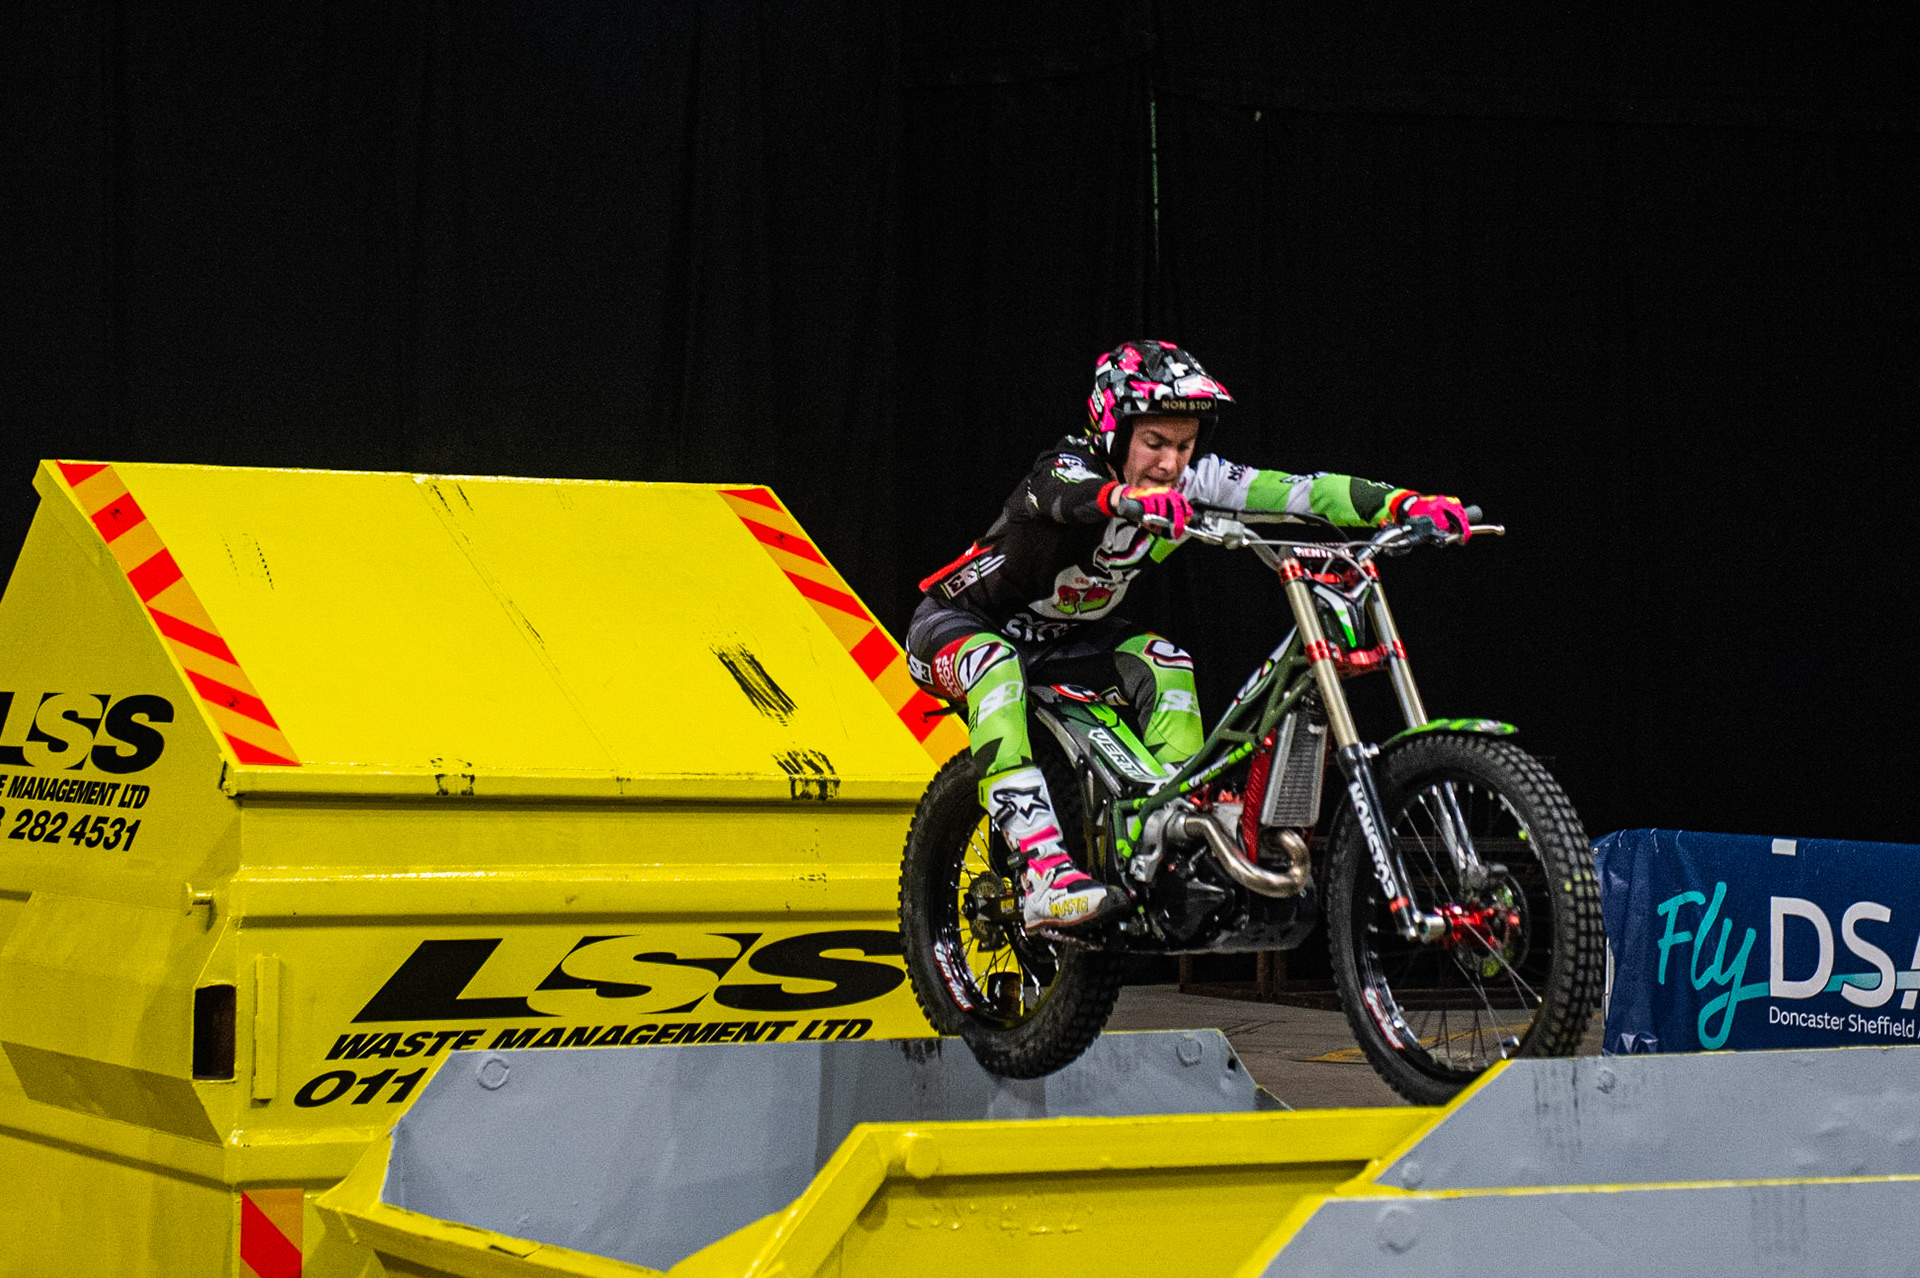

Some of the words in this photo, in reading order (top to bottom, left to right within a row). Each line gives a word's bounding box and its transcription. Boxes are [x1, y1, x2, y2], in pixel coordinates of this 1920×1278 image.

[1161, 400, 1187, 411] NON
[1188, 400, 1212, 411] STOP
[7, 775, 121, 808] MANAGEMENT
[118, 783, 150, 810] LTD
[8, 808, 69, 844] 282
[68, 814, 142, 852] 4531
[350, 928, 907, 1024] LSS
[1657, 881, 1758, 1050] Fly
[1769, 896, 1920, 1010] DS
[325, 1030, 487, 1061] WASTE
[487, 1021, 797, 1051] MANAGEMENT
[796, 1018, 873, 1043] LTD
[1769, 1006, 1845, 1031] Doncaster
[1848, 1013, 1915, 1039] Sheffield
[293, 1067, 429, 1108] 011
